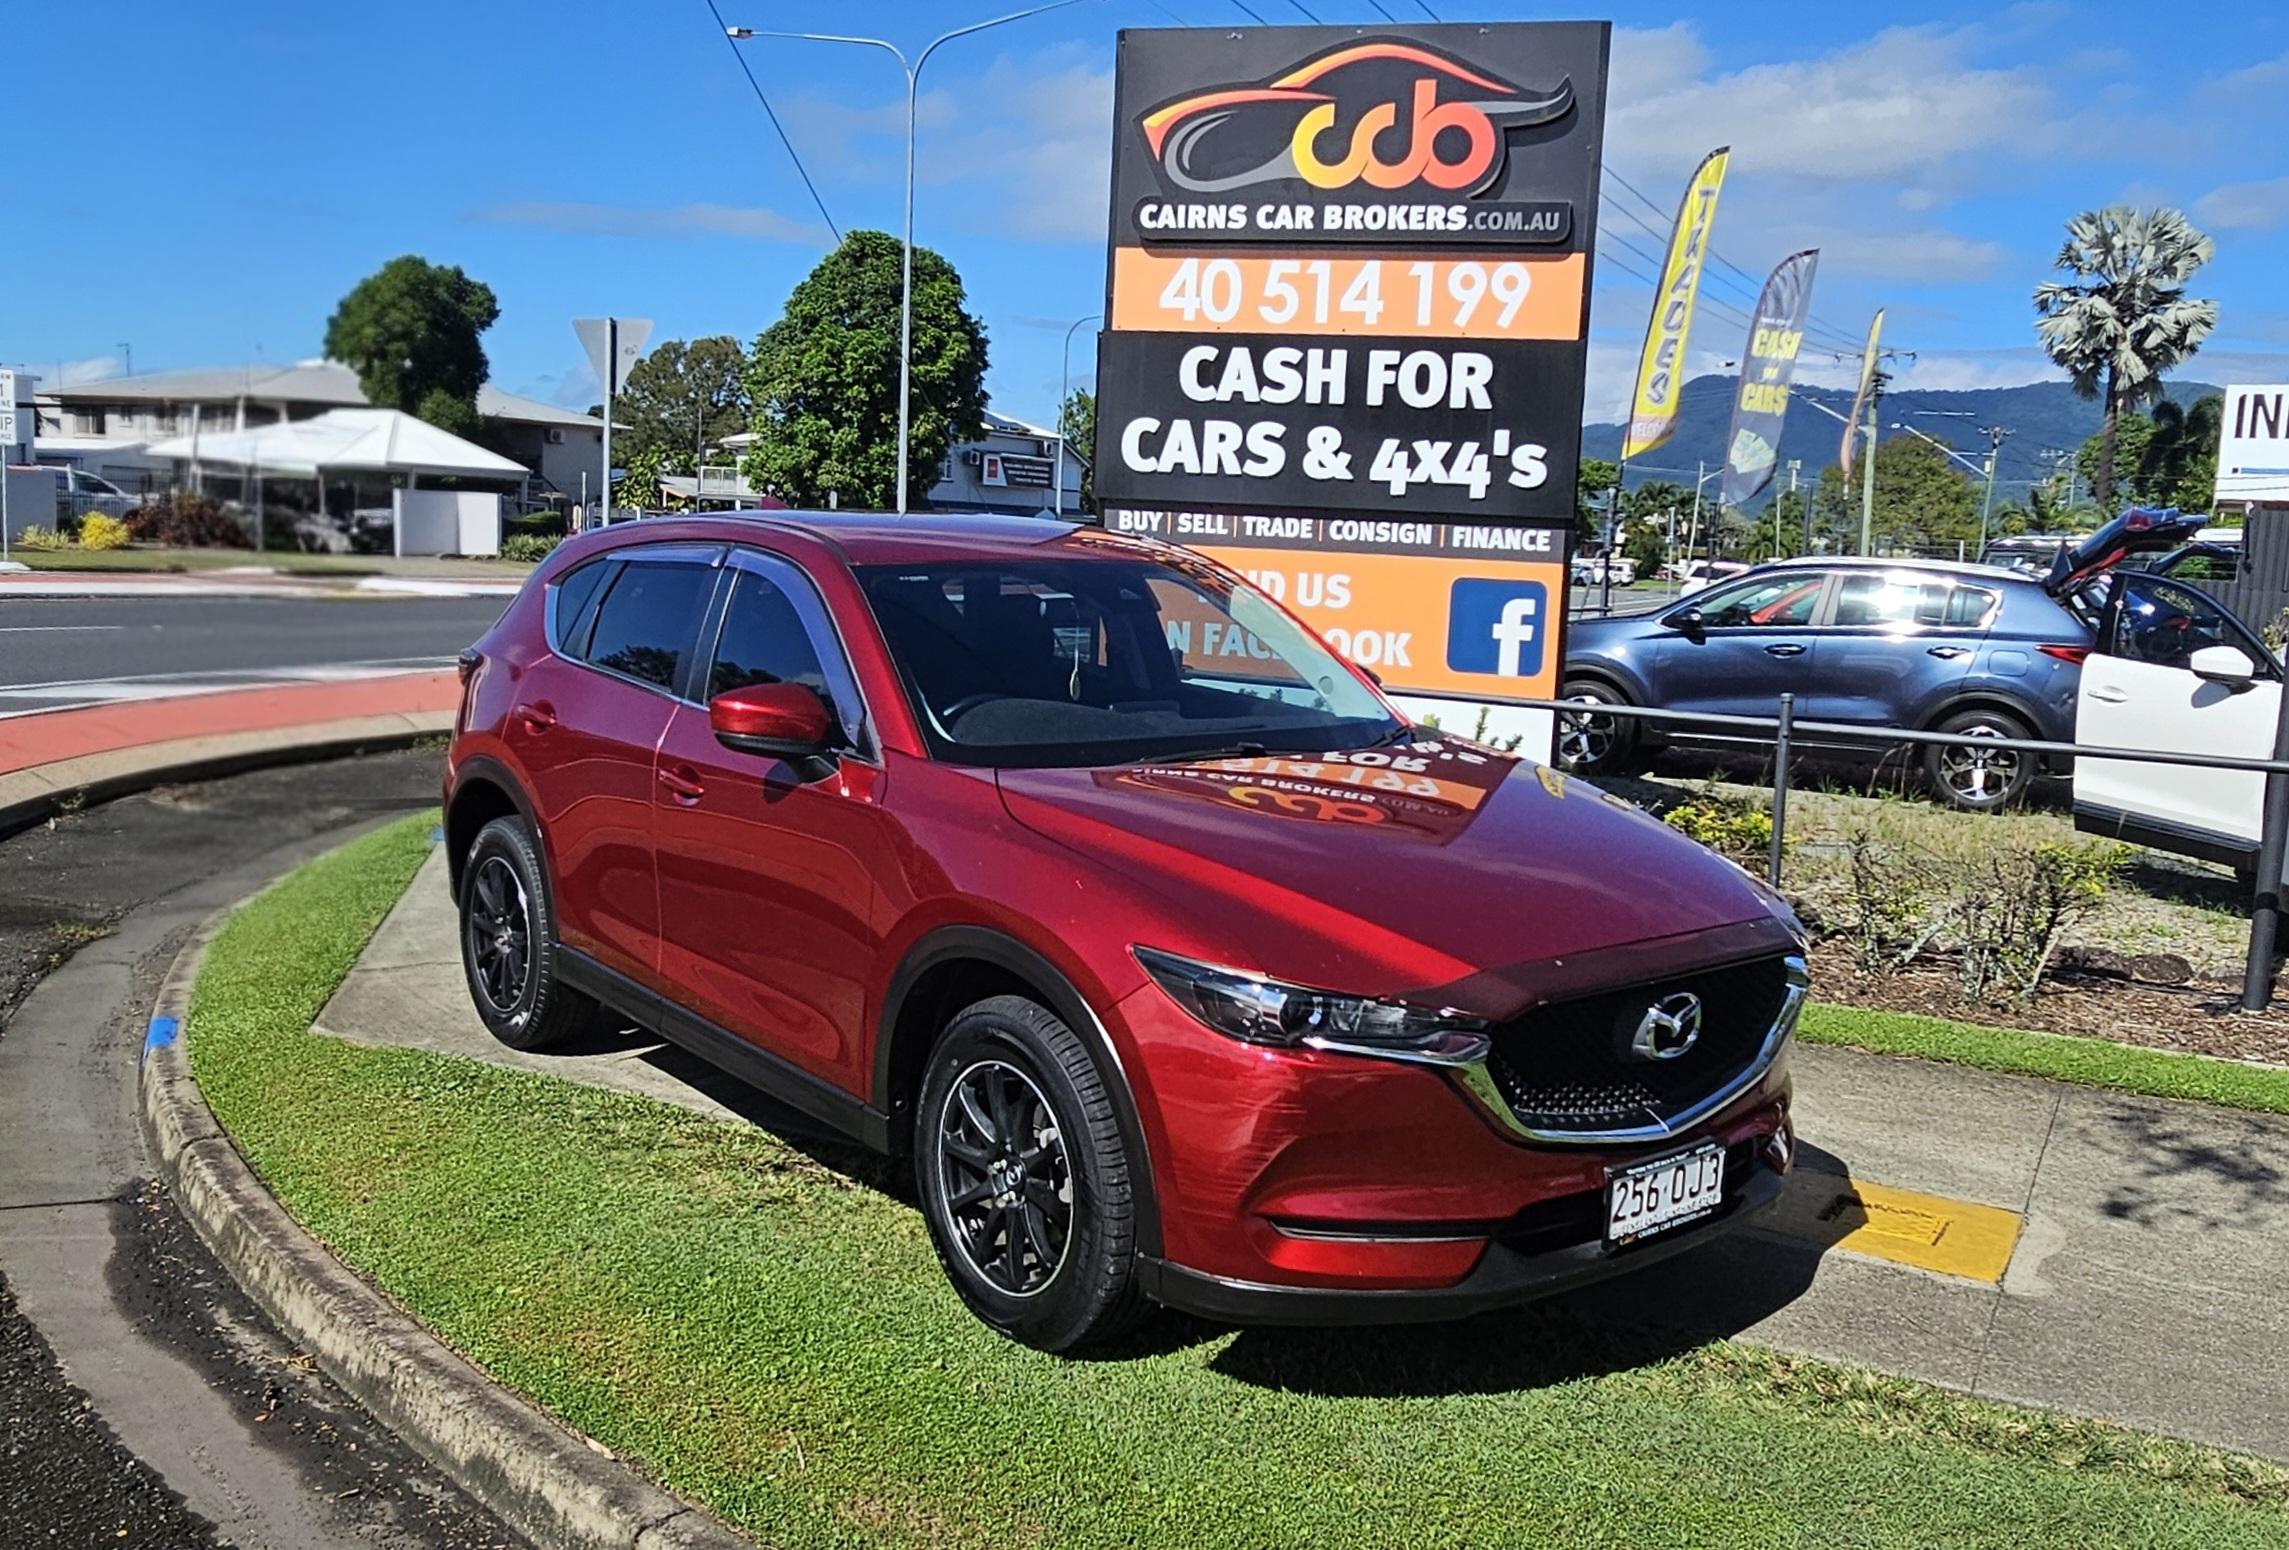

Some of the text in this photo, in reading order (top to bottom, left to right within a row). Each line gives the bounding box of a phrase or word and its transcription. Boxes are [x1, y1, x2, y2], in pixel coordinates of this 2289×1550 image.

[1140, 203, 1247, 231] CAIRNS
[1256, 204, 1314, 231] CAR
[1159, 257, 1531, 328] 40 514 199
[1646, 186, 1717, 406] TRADES
[1179, 345, 1494, 410] CASH FOR
[1121, 417, 1287, 477] CARS
[1303, 426, 1353, 481] &
[1118, 511, 1551, 552] BUY SELL TRADE CONSIGN FINANCE
[1297, 572, 1352, 609] US
[1166, 621, 1191, 655] N
